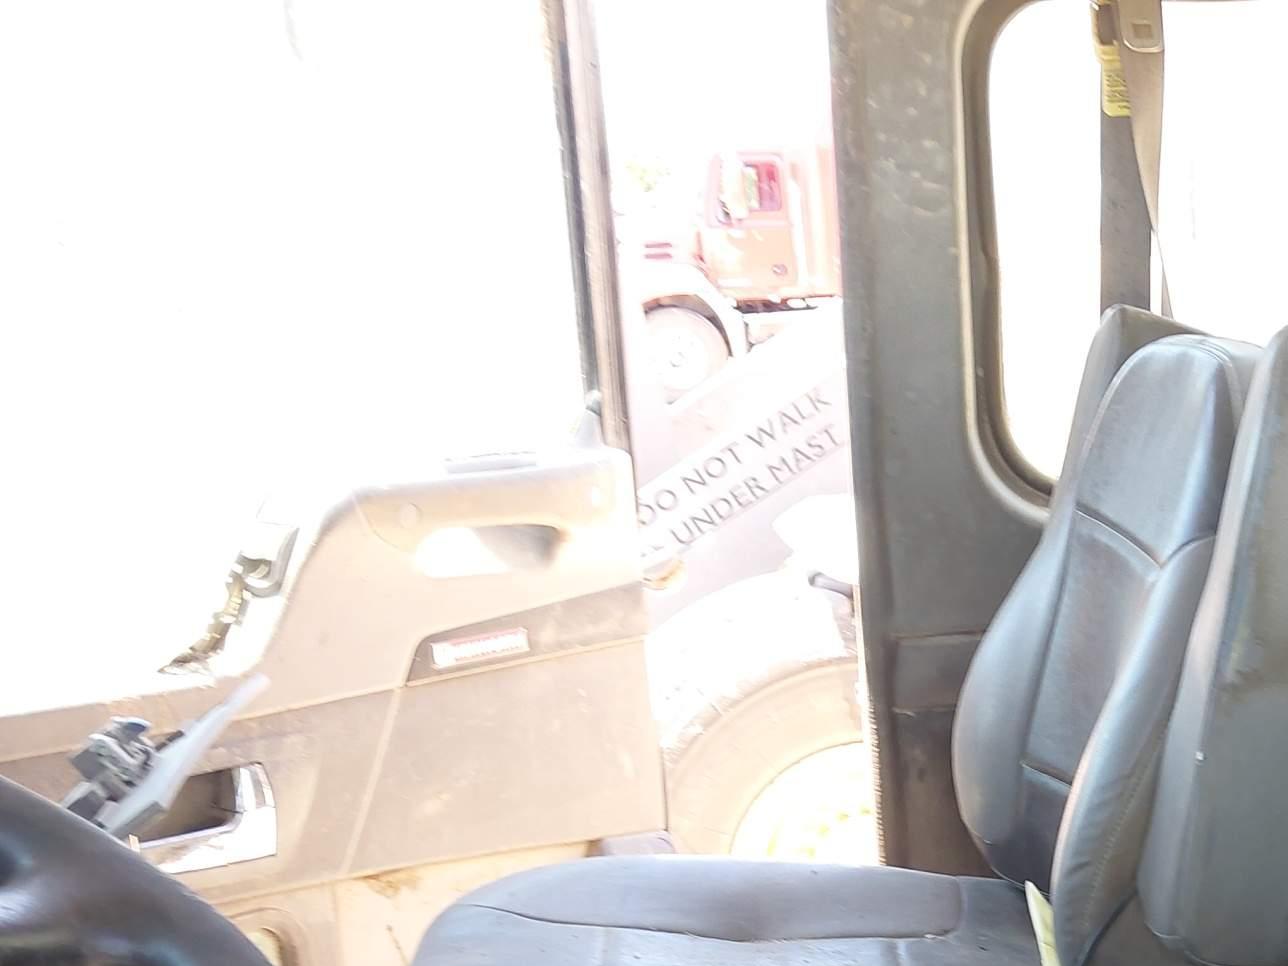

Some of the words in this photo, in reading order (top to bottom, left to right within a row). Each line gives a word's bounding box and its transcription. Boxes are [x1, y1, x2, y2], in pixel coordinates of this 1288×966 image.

[637, 488, 678, 526] DO
[680, 441, 743, 495] NOT
[745, 386, 832, 449] WALK
[669, 475, 769, 545] UNDER
[767, 423, 840, 484] MAST
